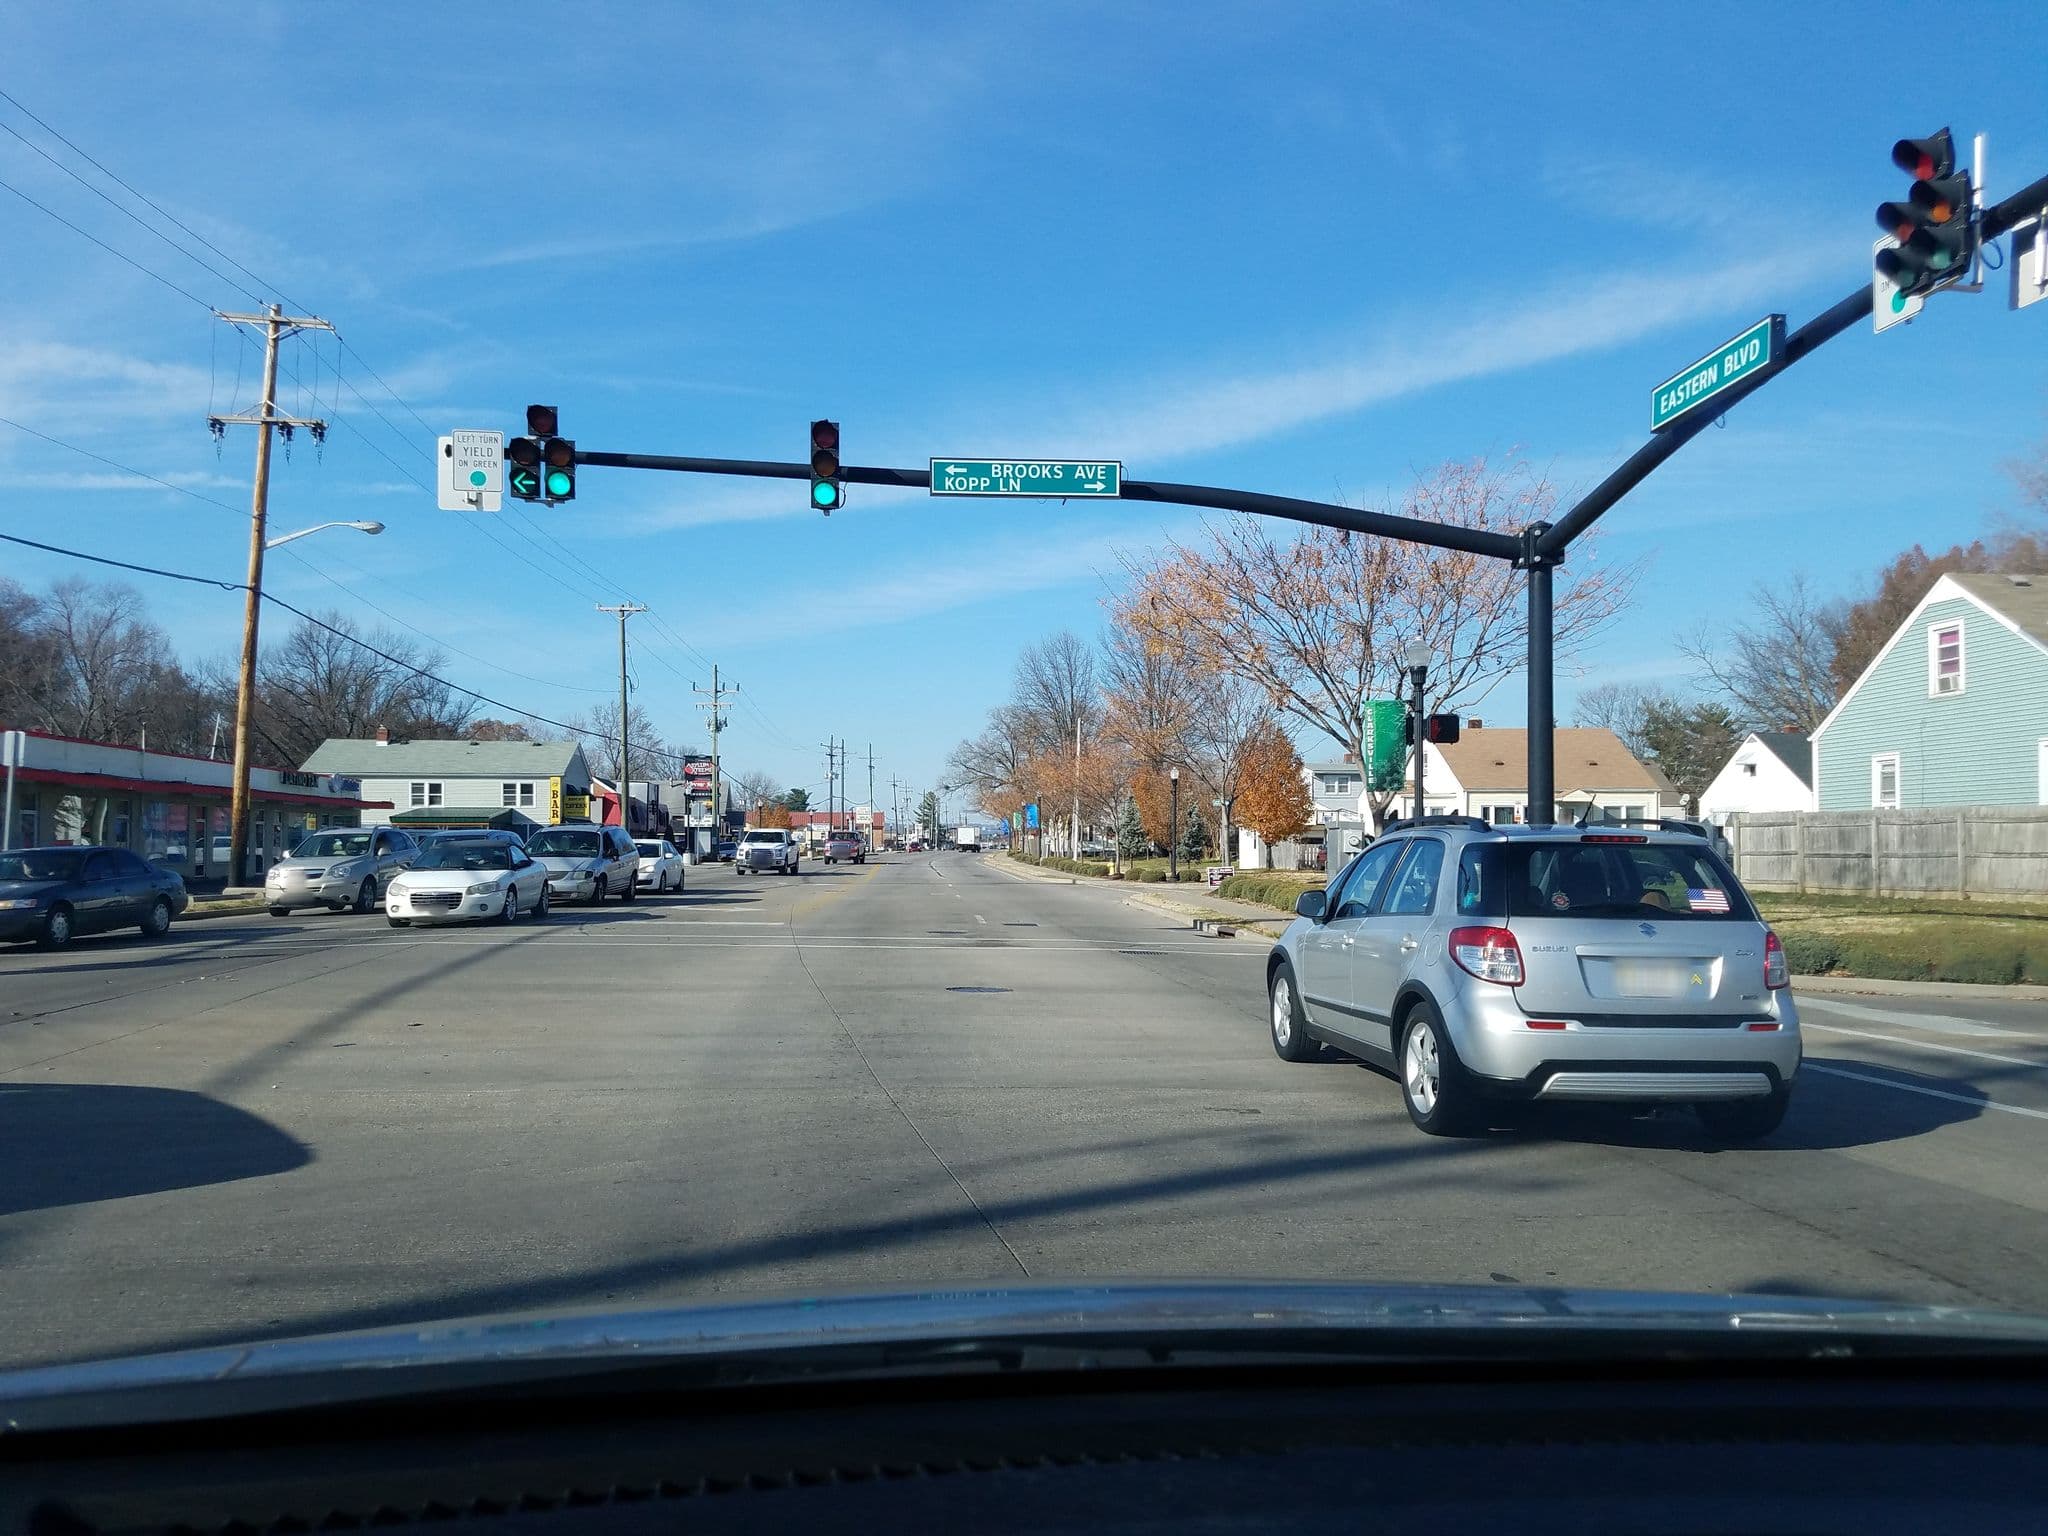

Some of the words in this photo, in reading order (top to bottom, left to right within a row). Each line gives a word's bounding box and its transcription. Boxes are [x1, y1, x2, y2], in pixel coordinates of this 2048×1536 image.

[1660, 364, 1719, 414] EASTERN
[1724, 338, 1760, 377] BLVD
[457, 434, 475, 444] LEFT
[479, 435, 499, 444] TURN
[463, 446, 494, 458] YIELD
[458, 459, 469, 468] ON
[473, 460, 498, 469] GREEN
[991, 464, 1063, 479] BROOKS
[1074, 465, 1106, 480] AVE
[944, 476, 990, 491] KOPP
[1000, 477, 1021, 492] LN
[1366, 708, 1375, 784] CLARKSVILLE
[551, 789, 560, 819] BAR
[1531, 945, 1569, 953] SUZUKI
